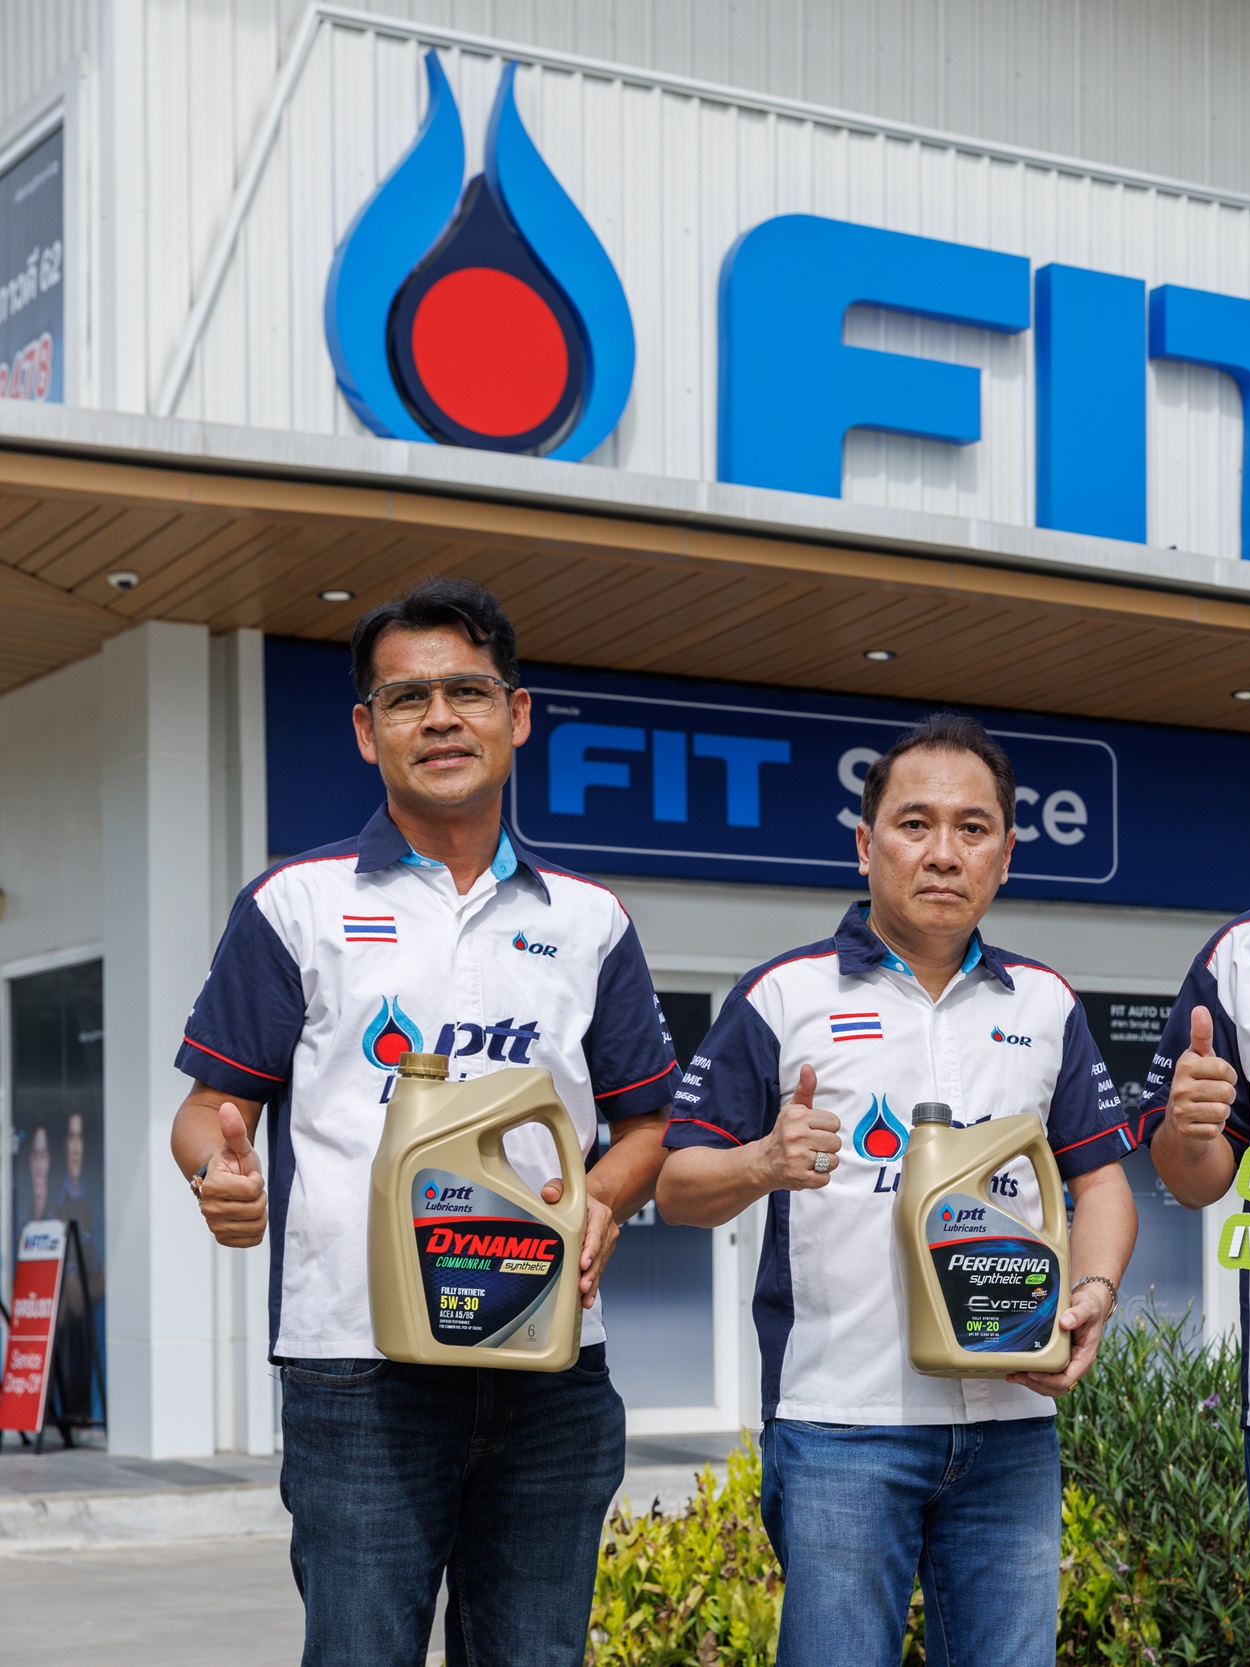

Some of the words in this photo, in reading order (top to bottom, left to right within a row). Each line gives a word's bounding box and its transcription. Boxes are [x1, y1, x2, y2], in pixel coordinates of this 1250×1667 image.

[548, 722, 791, 828] FIT
[528, 941, 558, 959] OR
[433, 1016, 541, 1065] ptt
[1006, 1034, 1032, 1047] OR
[440, 1186, 473, 1201] ptt
[425, 1201, 473, 1213] Lubricants
[956, 1207, 986, 1223] ptt
[943, 1223, 987, 1233] Lubricants
[425, 1227, 559, 1261] DYNAMIC
[435, 1256, 492, 1271] COMMONRAIL
[504, 1261, 547, 1272] synthetic
[948, 1254, 1050, 1273] PERFORMA
[969, 1272, 1023, 1286] synthetic
[440, 1286, 457, 1295] FULLY
[458, 1287, 486, 1297] SYNTHETIC
[440, 1295, 479, 1311] 5W-30
[439, 1310, 454, 1318] ACEA
[527, 1324, 535, 1337] 6
[966, 1321, 1000, 1332] 0W-20
